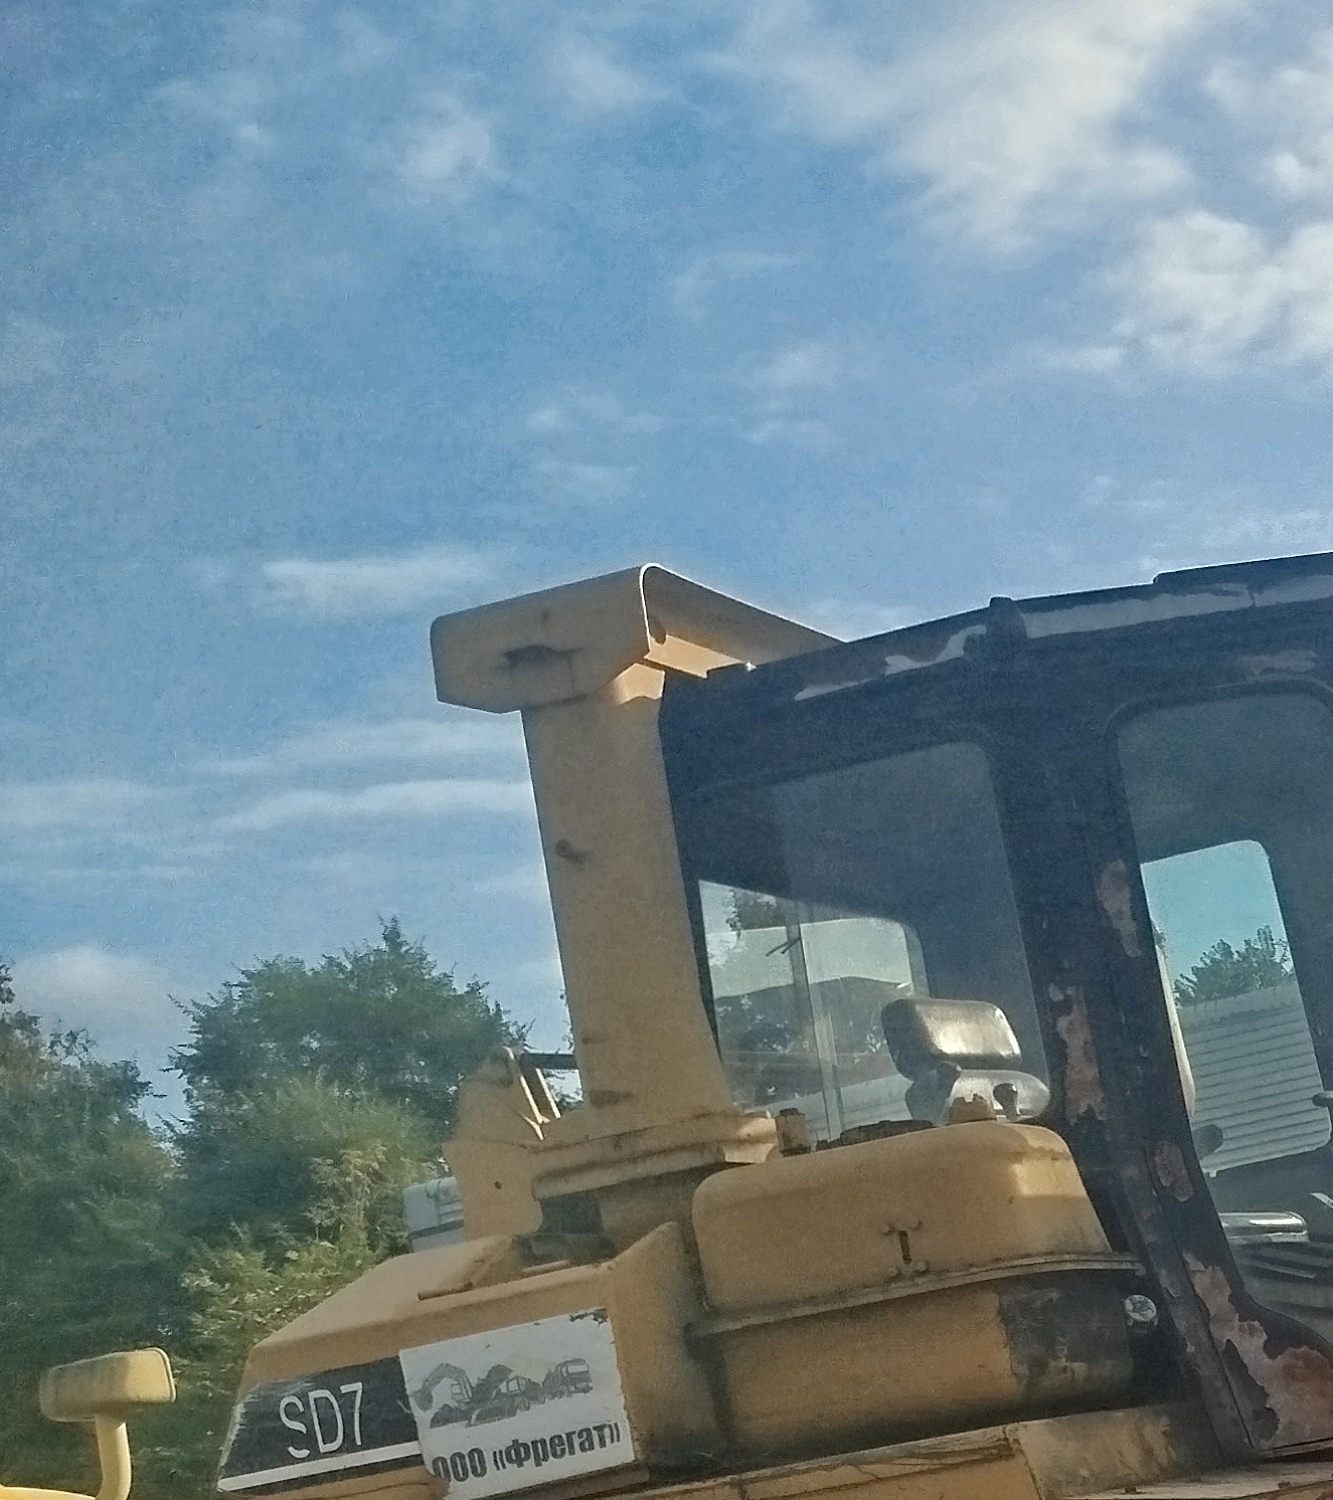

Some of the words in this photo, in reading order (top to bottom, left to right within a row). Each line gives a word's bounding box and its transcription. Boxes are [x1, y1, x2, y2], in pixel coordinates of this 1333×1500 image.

[279, 1381, 363, 1459] SD7
[431, 1447, 488, 1483] ООО
[492, 1421, 621, 1472] «Фрегат»
